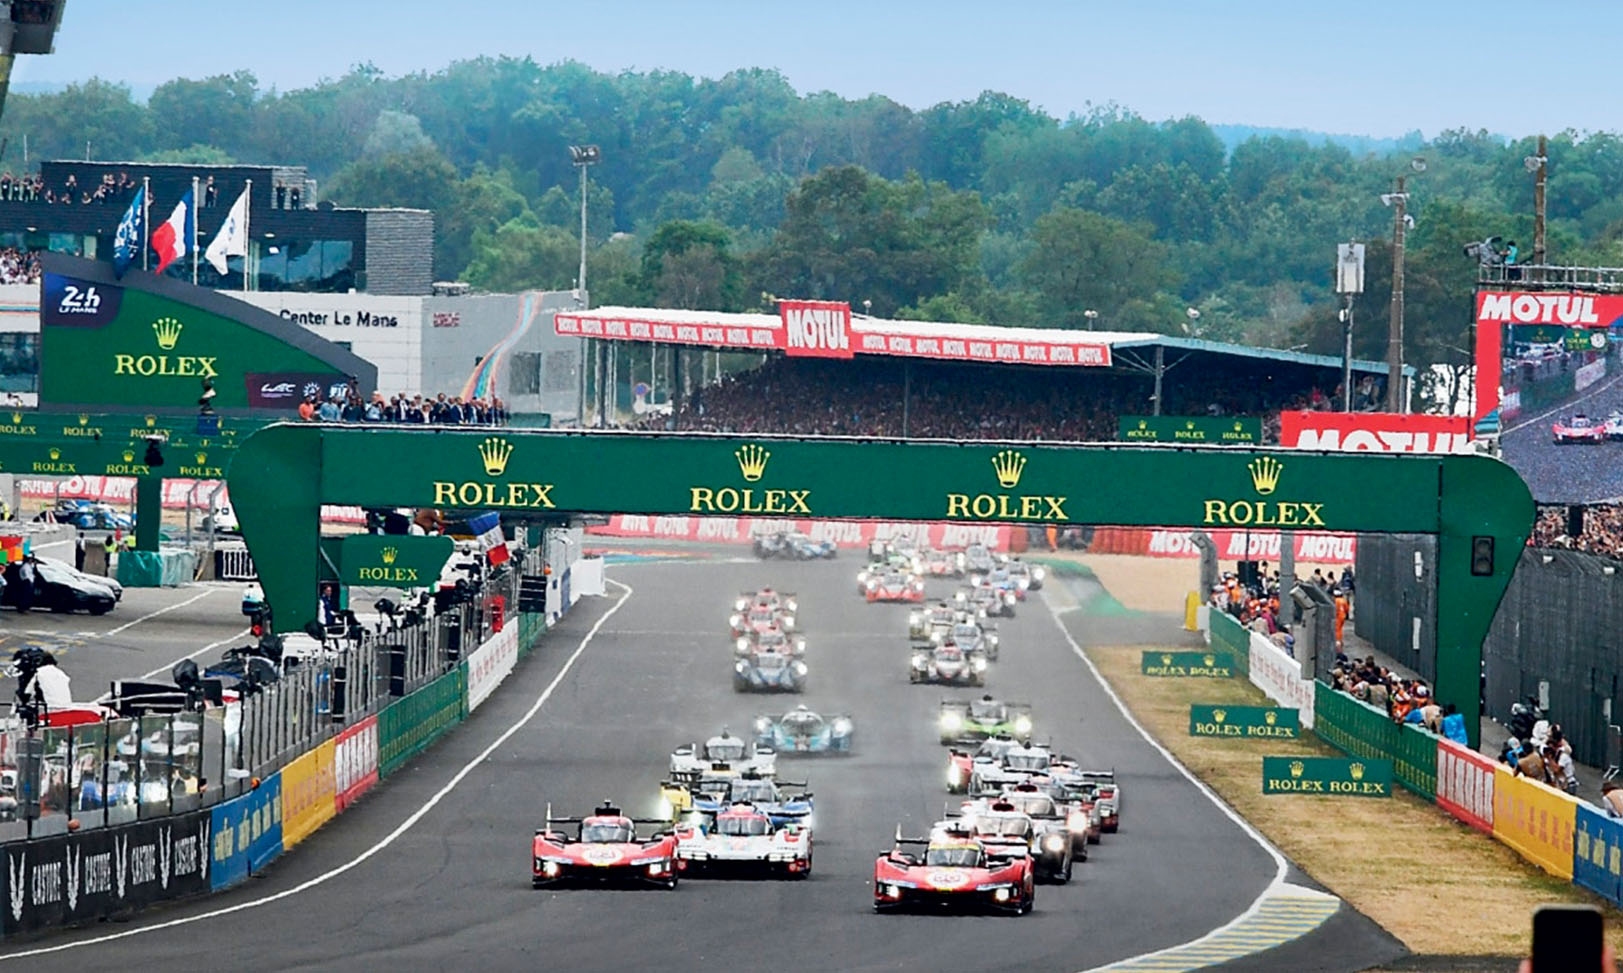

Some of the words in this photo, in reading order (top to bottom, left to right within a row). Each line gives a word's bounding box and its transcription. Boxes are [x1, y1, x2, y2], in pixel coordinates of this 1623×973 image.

[1479, 294, 1598, 323] MOTUL
[280, 309, 328, 325] Center
[334, 311, 350, 326] Le
[357, 311, 398, 328] Mans
[786, 308, 849, 350] MOTUL
[115, 354, 218, 376] ROLEX
[64, 427, 103, 438] ROLEX
[33, 462, 76, 473] ROLEX
[106, 464, 150, 475] ROLEX
[180, 467, 222, 477] ROLEX
[433, 481, 556, 508] ROLEX
[690, 487, 812, 513] ROLEX
[946, 494, 1068, 519] ROLEX
[1203, 500, 1326, 526] ROLEX
[1226, 532, 1281, 556] MOTU
[1299, 536, 1354, 560] MOTUL
[358, 567, 418, 581] ROLEX
[1147, 667, 1186, 676] ROLEX
[1190, 667, 1230, 677] ROLEX
[1196, 723, 1242, 735] ROLEX
[1248, 725, 1294, 738] ROLEX
[1269, 779, 1323, 792] ROLEX
[1329, 780, 1385, 793] ROLEX
